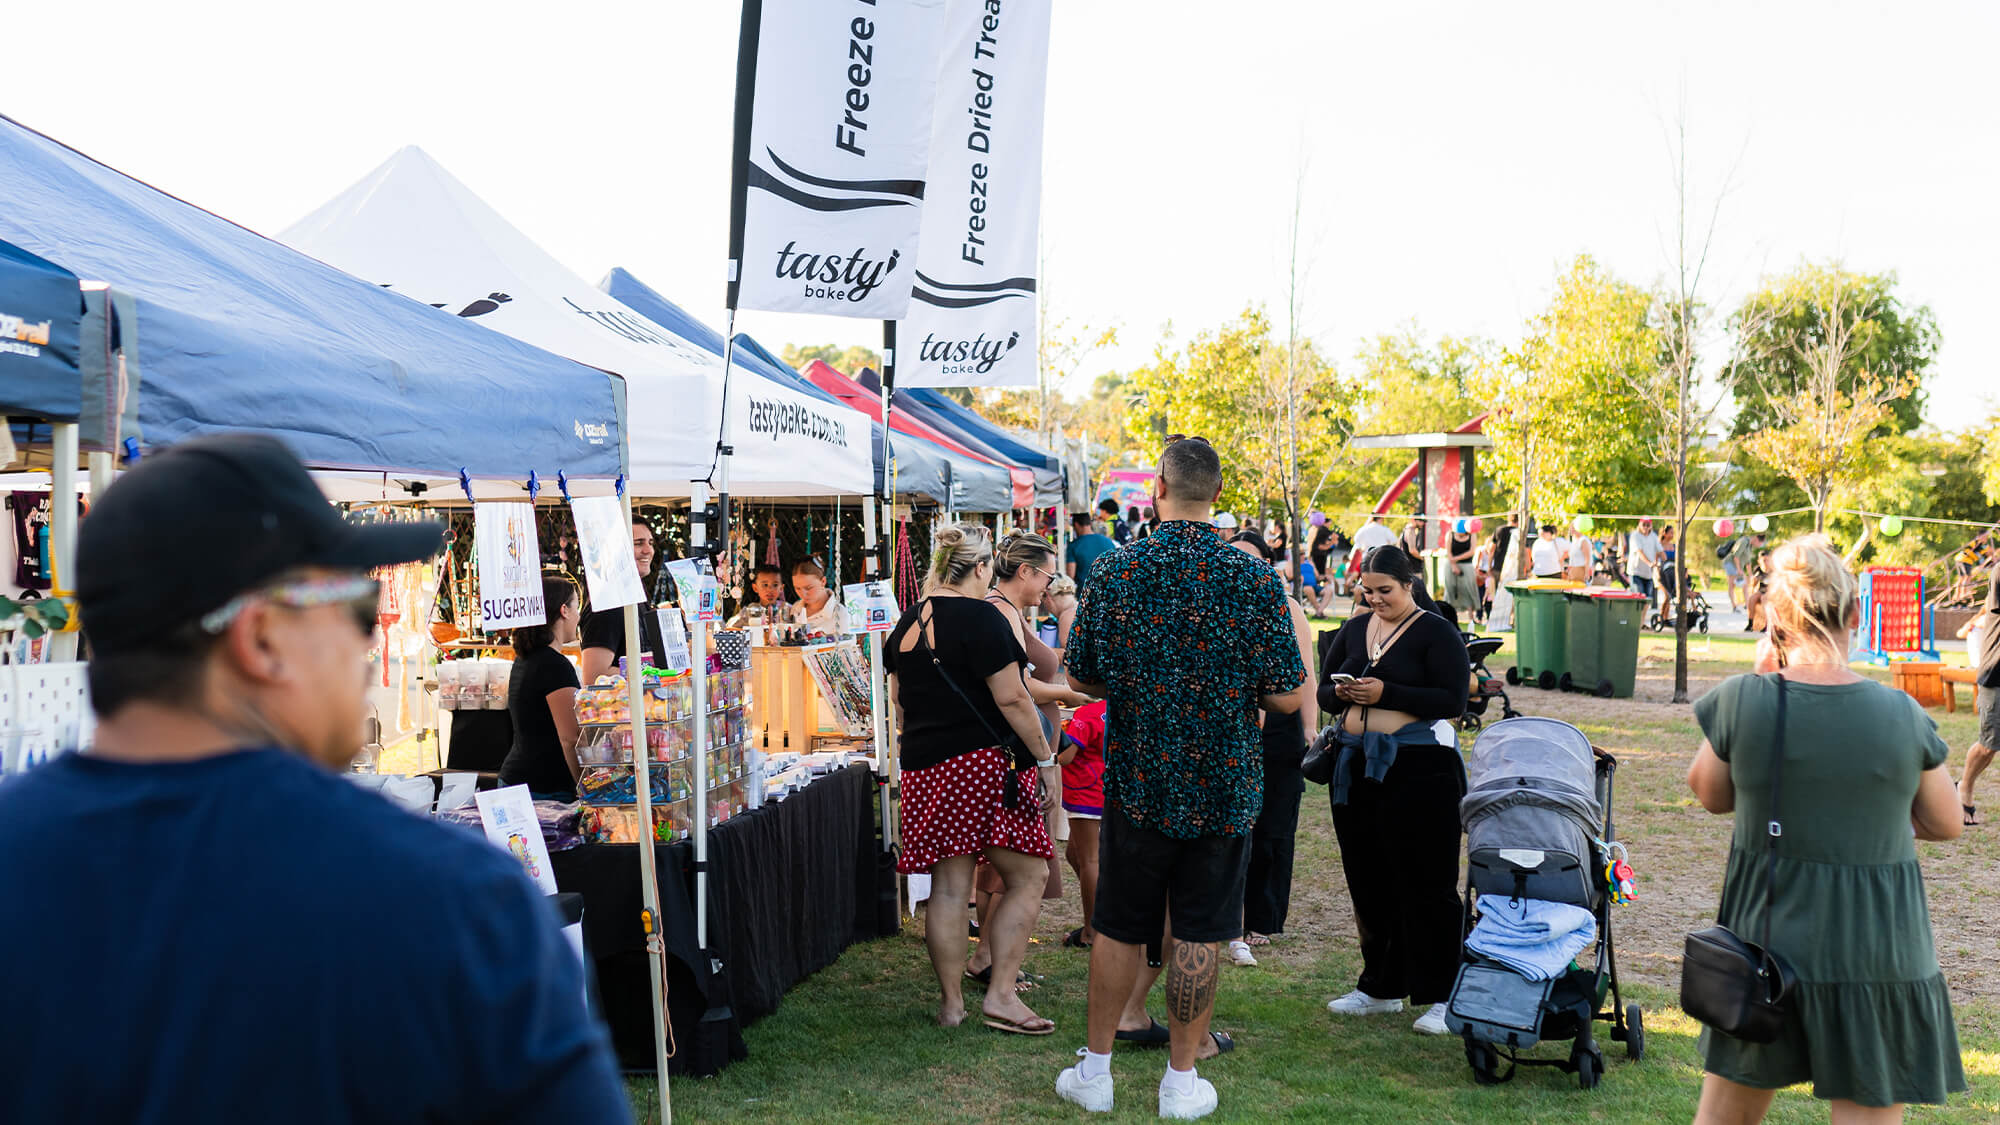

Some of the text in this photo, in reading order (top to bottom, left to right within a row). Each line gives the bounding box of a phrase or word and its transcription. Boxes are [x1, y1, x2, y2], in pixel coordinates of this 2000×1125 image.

[836, 17, 875, 157] Freeze
[968, 68, 993, 154] Dried
[962, 163, 988, 266] Freeze
[776, 241, 886, 302] tasty
[804, 284, 845, 300] bake
[920, 332, 1007, 374] tasty
[942, 364, 974, 374] bake
[748, 394, 848, 448] tastybake.com.au
[483, 597, 527, 621] SUGAR
